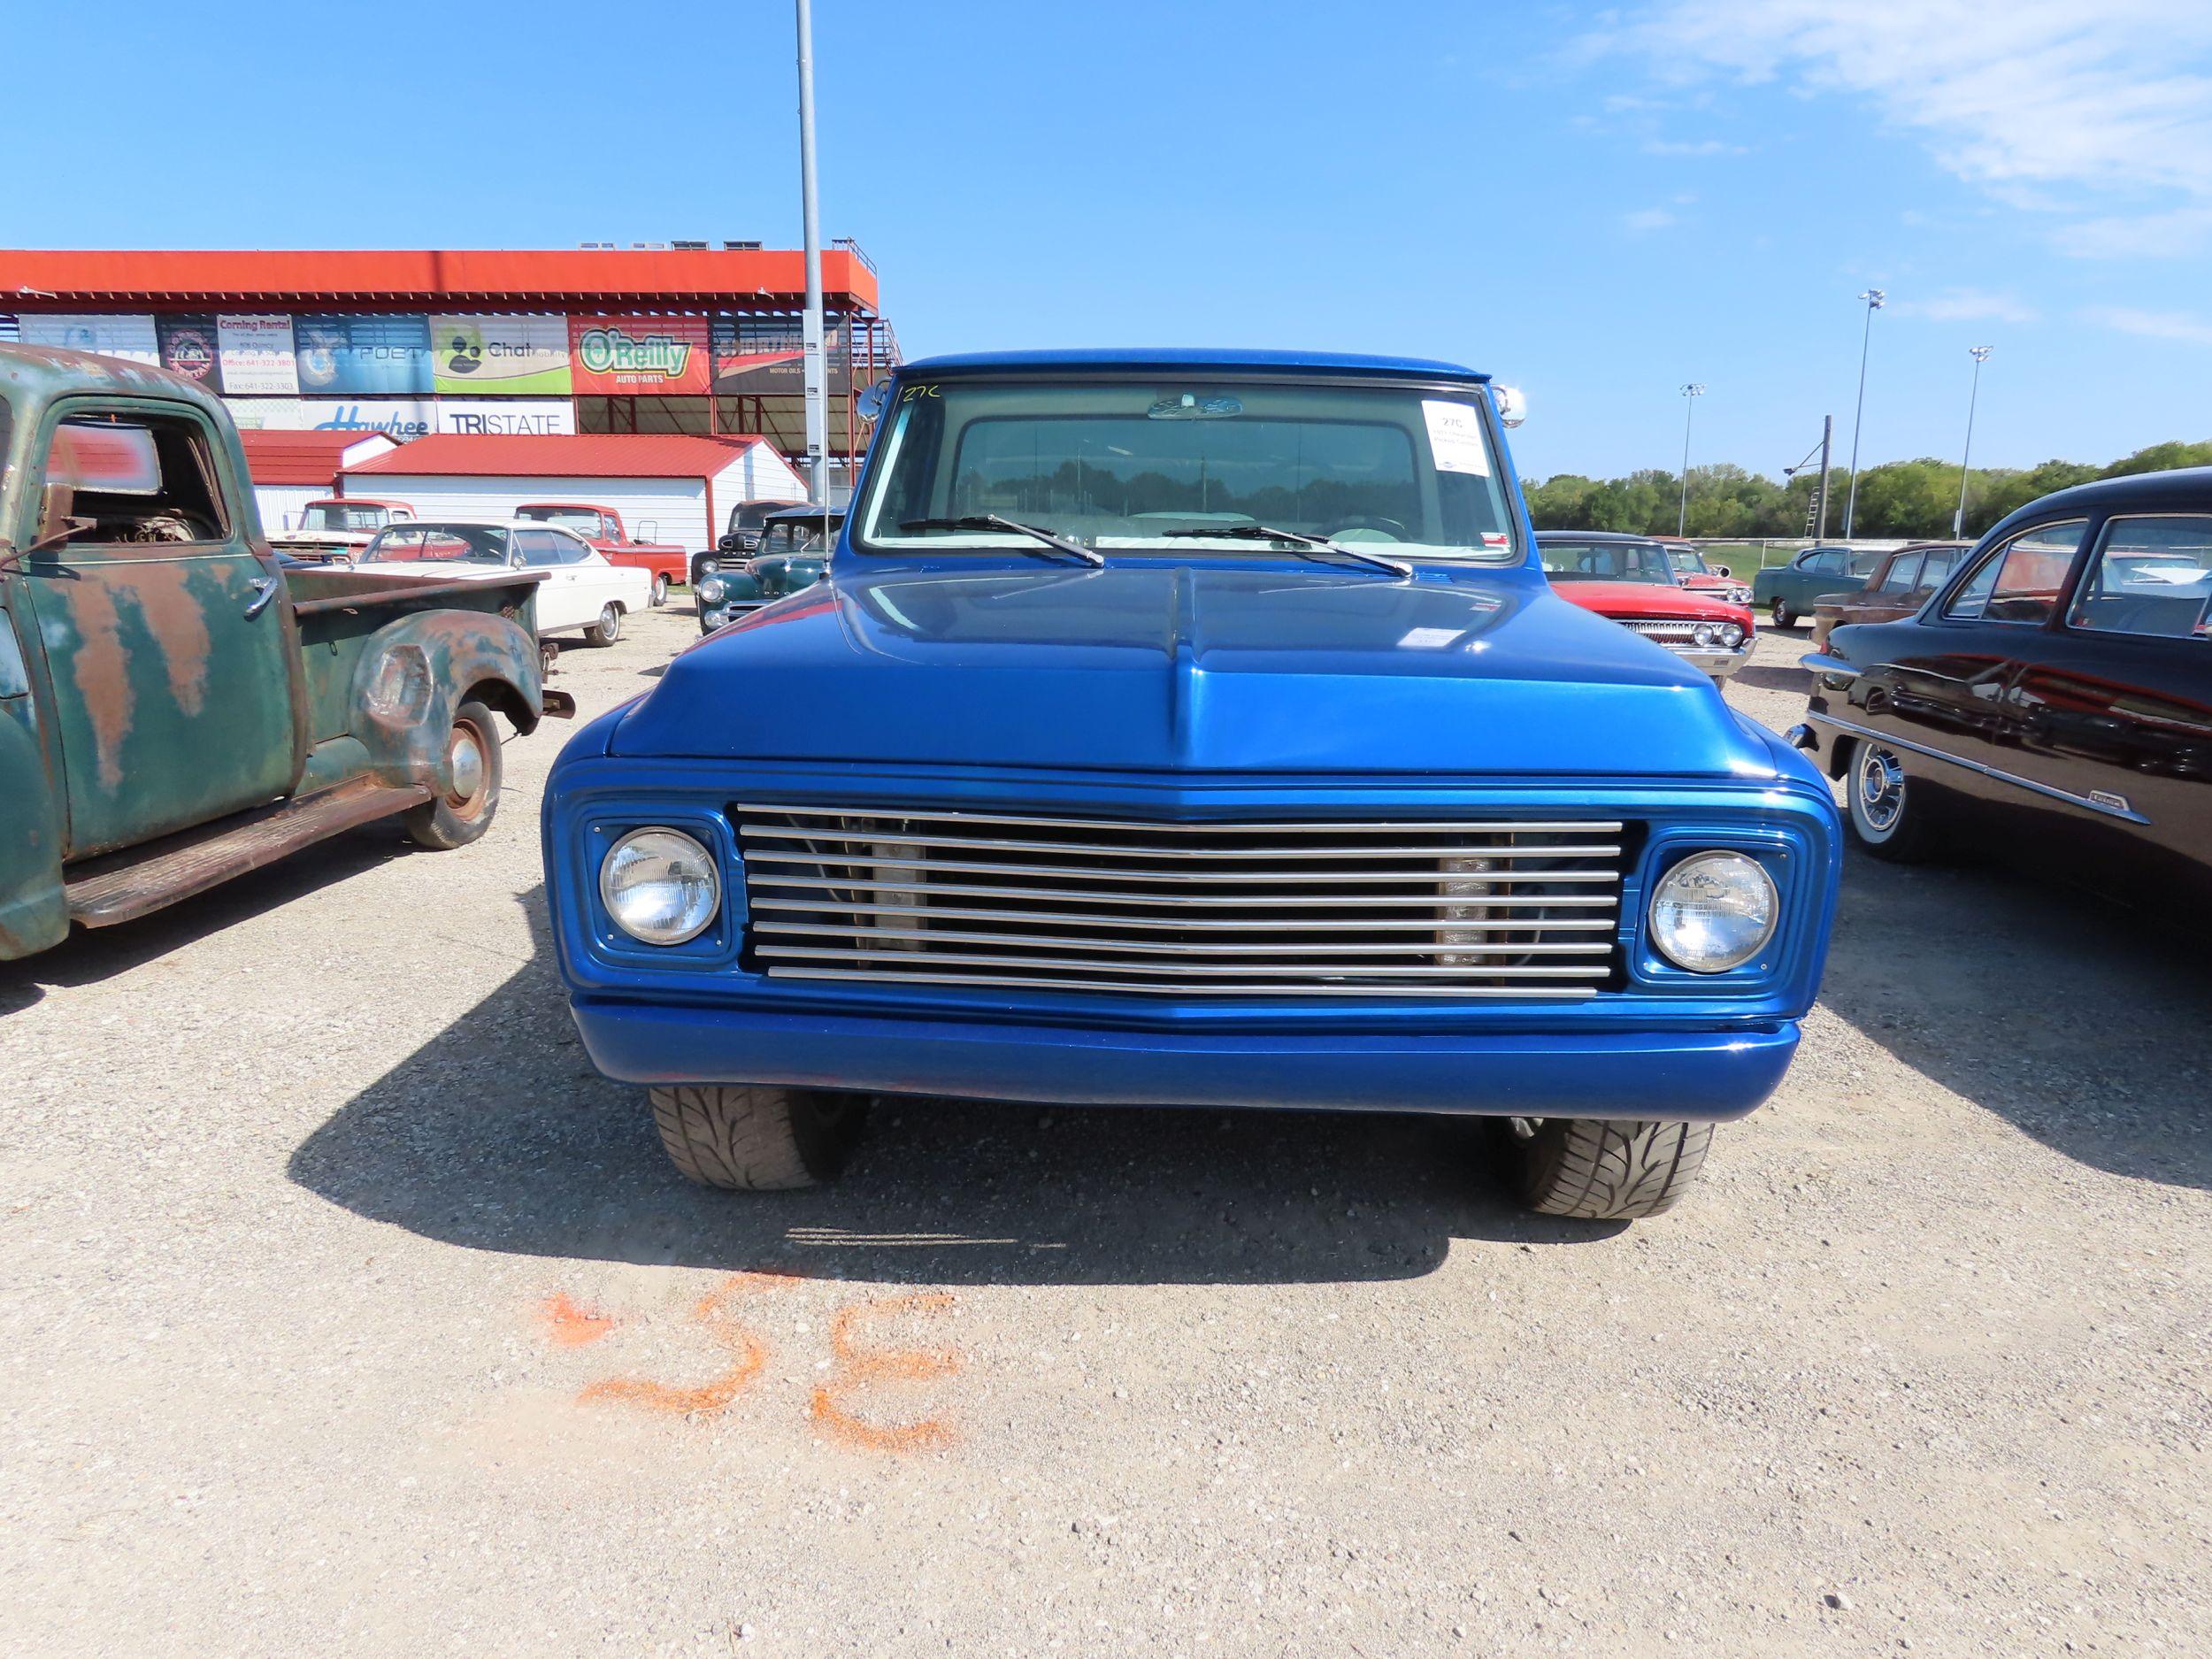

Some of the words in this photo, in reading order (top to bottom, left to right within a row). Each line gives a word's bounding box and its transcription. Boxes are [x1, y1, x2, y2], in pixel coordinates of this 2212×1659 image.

[259, 319, 291, 329] Rental
[360, 346, 423, 360] POET
[488, 342, 532, 357] Chat
[580, 328, 692, 376] O'Reilly
[616, 374, 637, 383] AUTO
[638, 374, 664, 383] PARTS
[902, 384, 941, 403] 27C
[449, 413, 561, 435] TRISTATE
